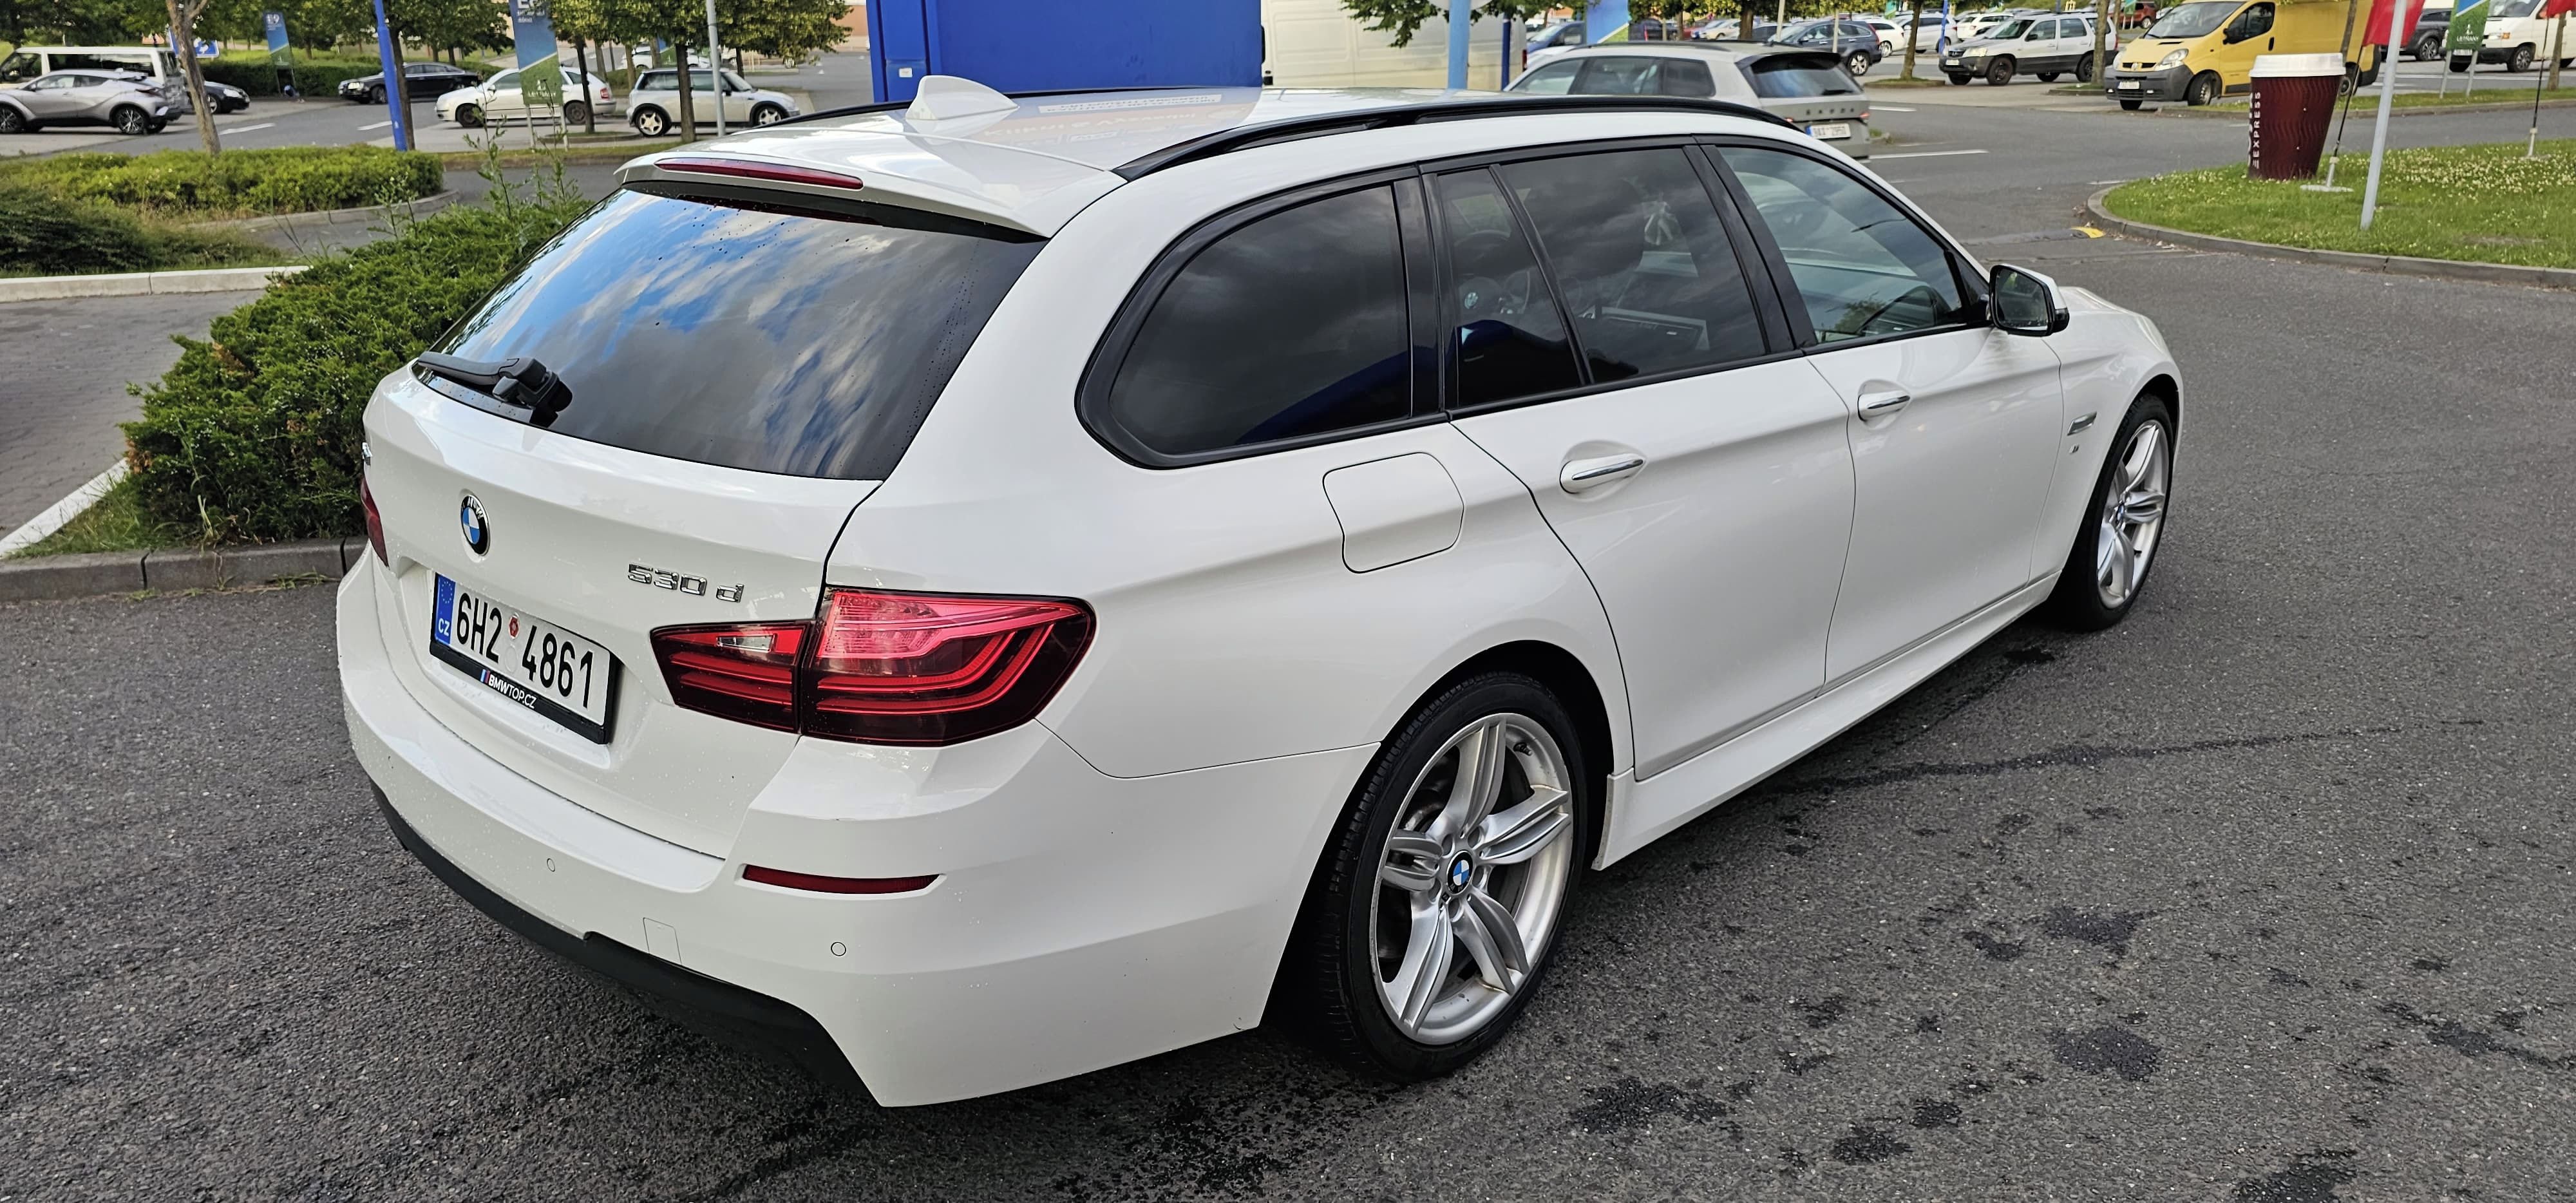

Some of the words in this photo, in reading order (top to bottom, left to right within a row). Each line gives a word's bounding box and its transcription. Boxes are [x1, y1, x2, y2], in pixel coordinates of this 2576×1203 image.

[2253, 91, 2261, 158] EXPRESS
[628, 563, 708, 596] 530
[715, 583, 744, 603] d
[437, 618, 451, 637] CZ
[456, 592, 503, 664] 6H2
[521, 625, 594, 709] 4861
[488, 676, 537, 709] BMWTOP.CZ
